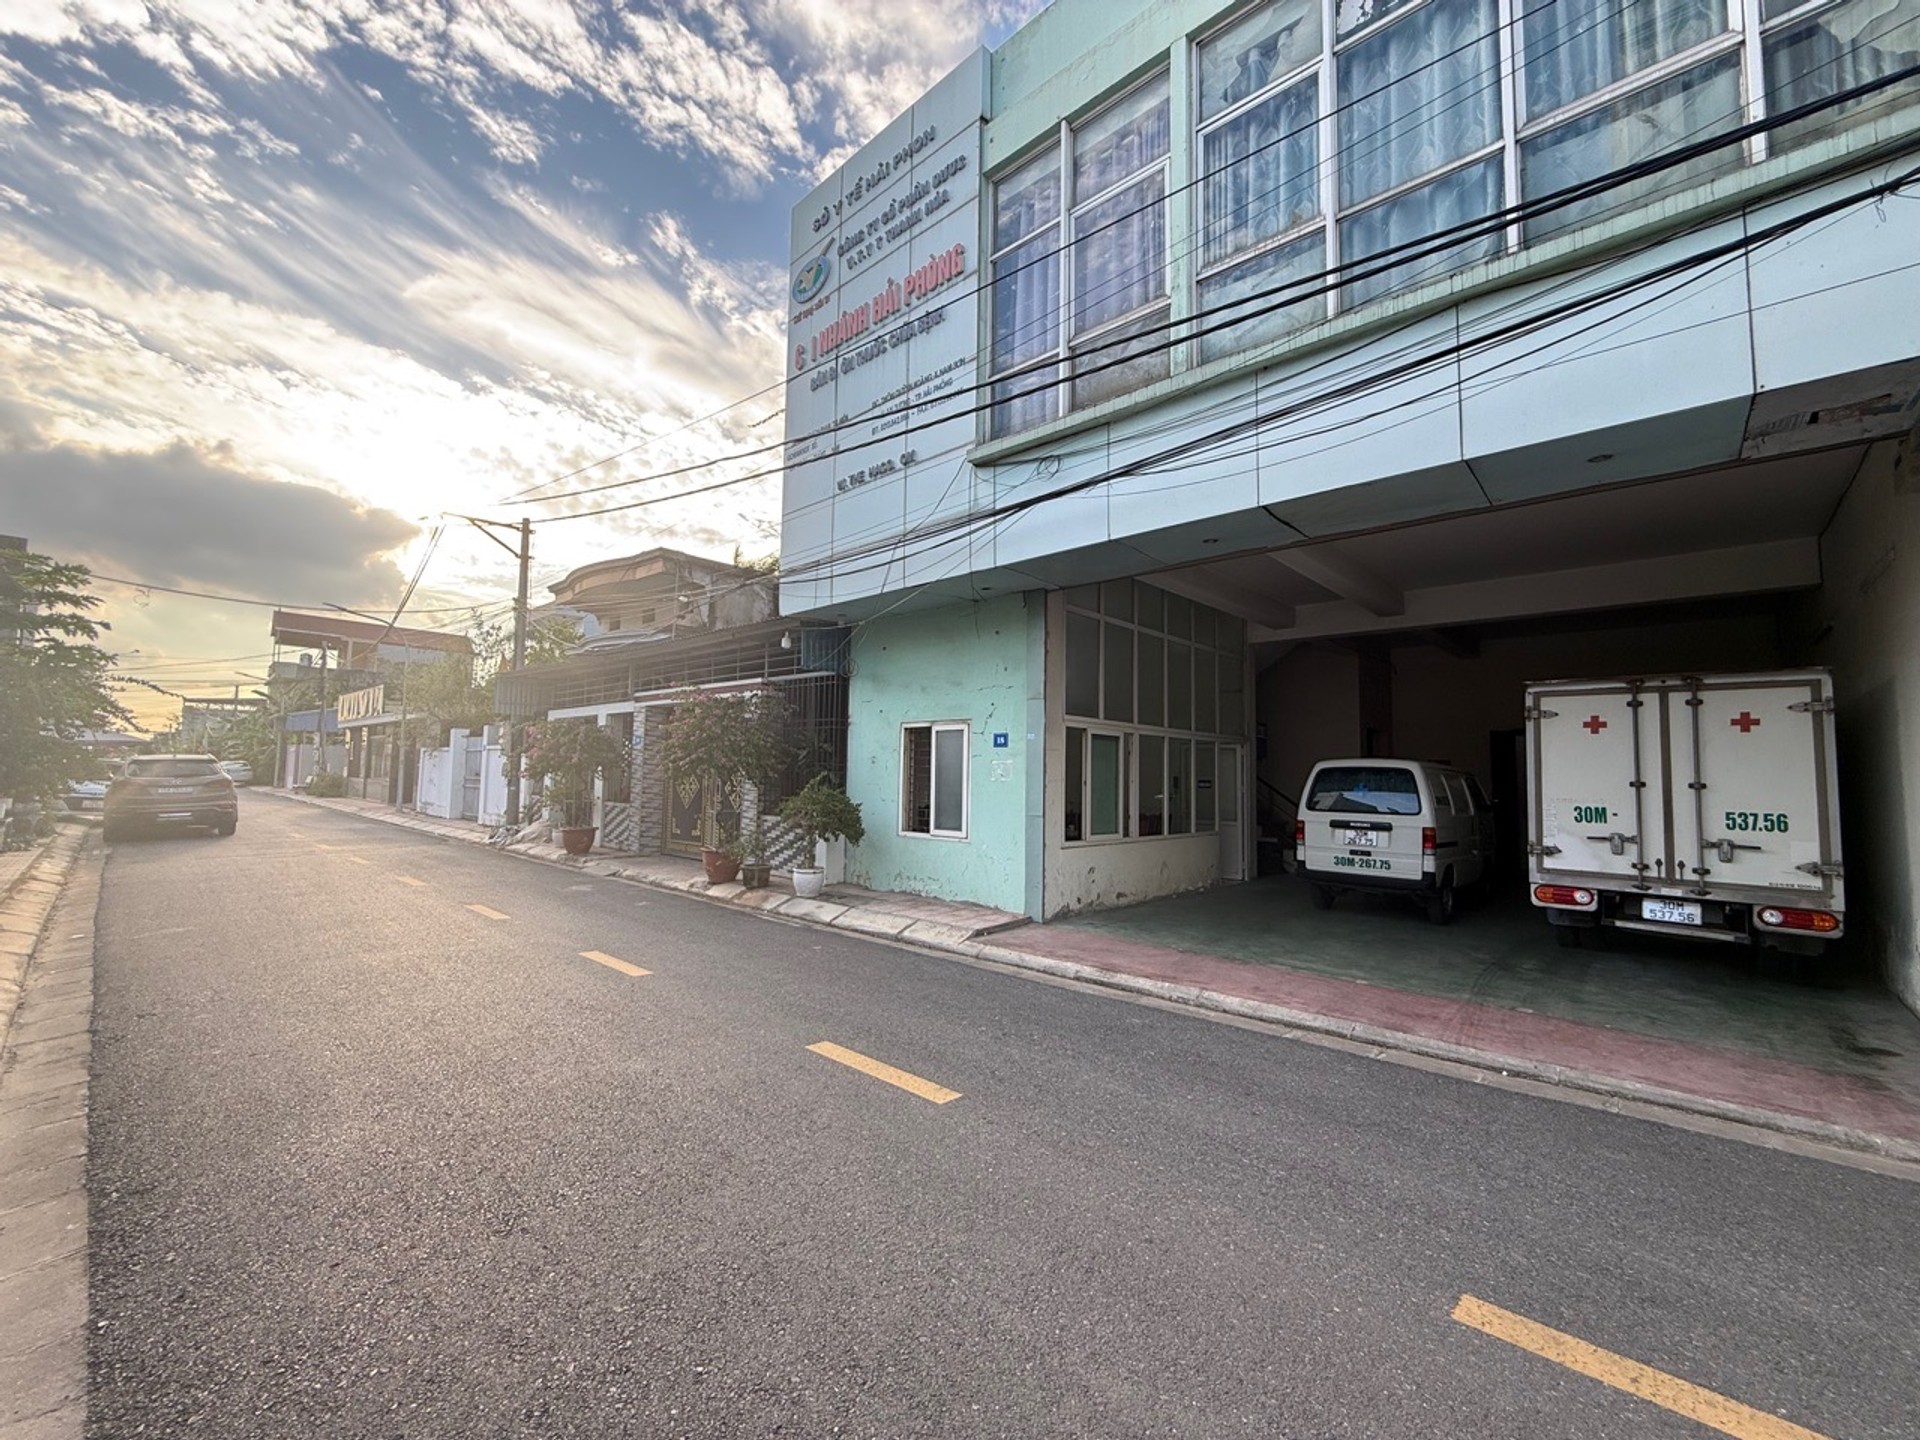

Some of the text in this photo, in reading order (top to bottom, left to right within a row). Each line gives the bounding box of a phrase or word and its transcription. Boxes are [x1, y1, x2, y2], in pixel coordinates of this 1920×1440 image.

[819, 302, 871, 358] NHÁNH
[903, 242, 966, 305] PHÒNG
[1573, 805, 1608, 824] 30M
[1725, 811, 1789, 833] 537.56
[1333, 856, 1392, 871] 30M-267.75
[1660, 900, 1685, 912] 30M
[1649, 909, 1695, 923] 537.56
